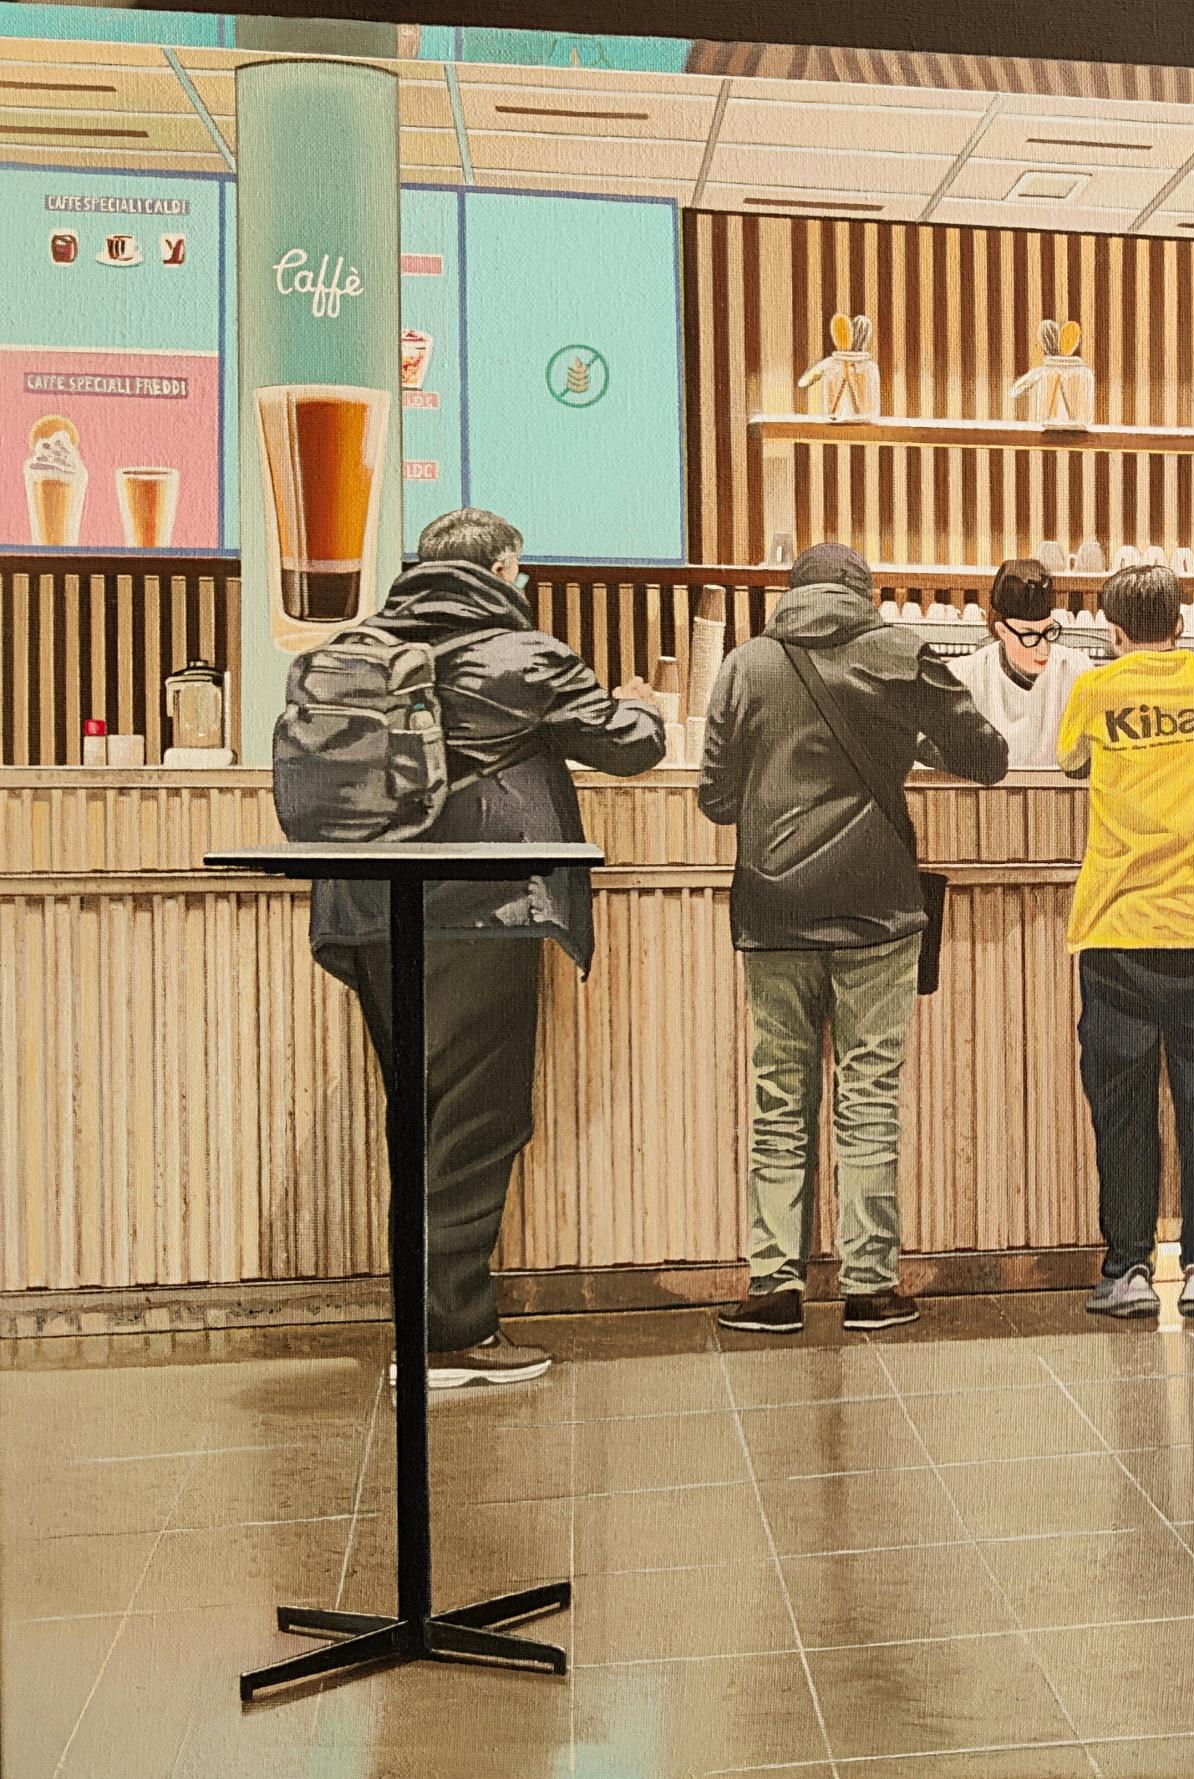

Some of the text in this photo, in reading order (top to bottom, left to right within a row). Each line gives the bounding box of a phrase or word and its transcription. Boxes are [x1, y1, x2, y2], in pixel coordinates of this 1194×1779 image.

[83, 196, 142, 213] SPECIALI
[144, 199, 186, 214] CALDI
[272, 248, 364, 318] Caffè
[69, 376, 130, 394] SPECIALI
[135, 377, 186, 396] FREDDI
